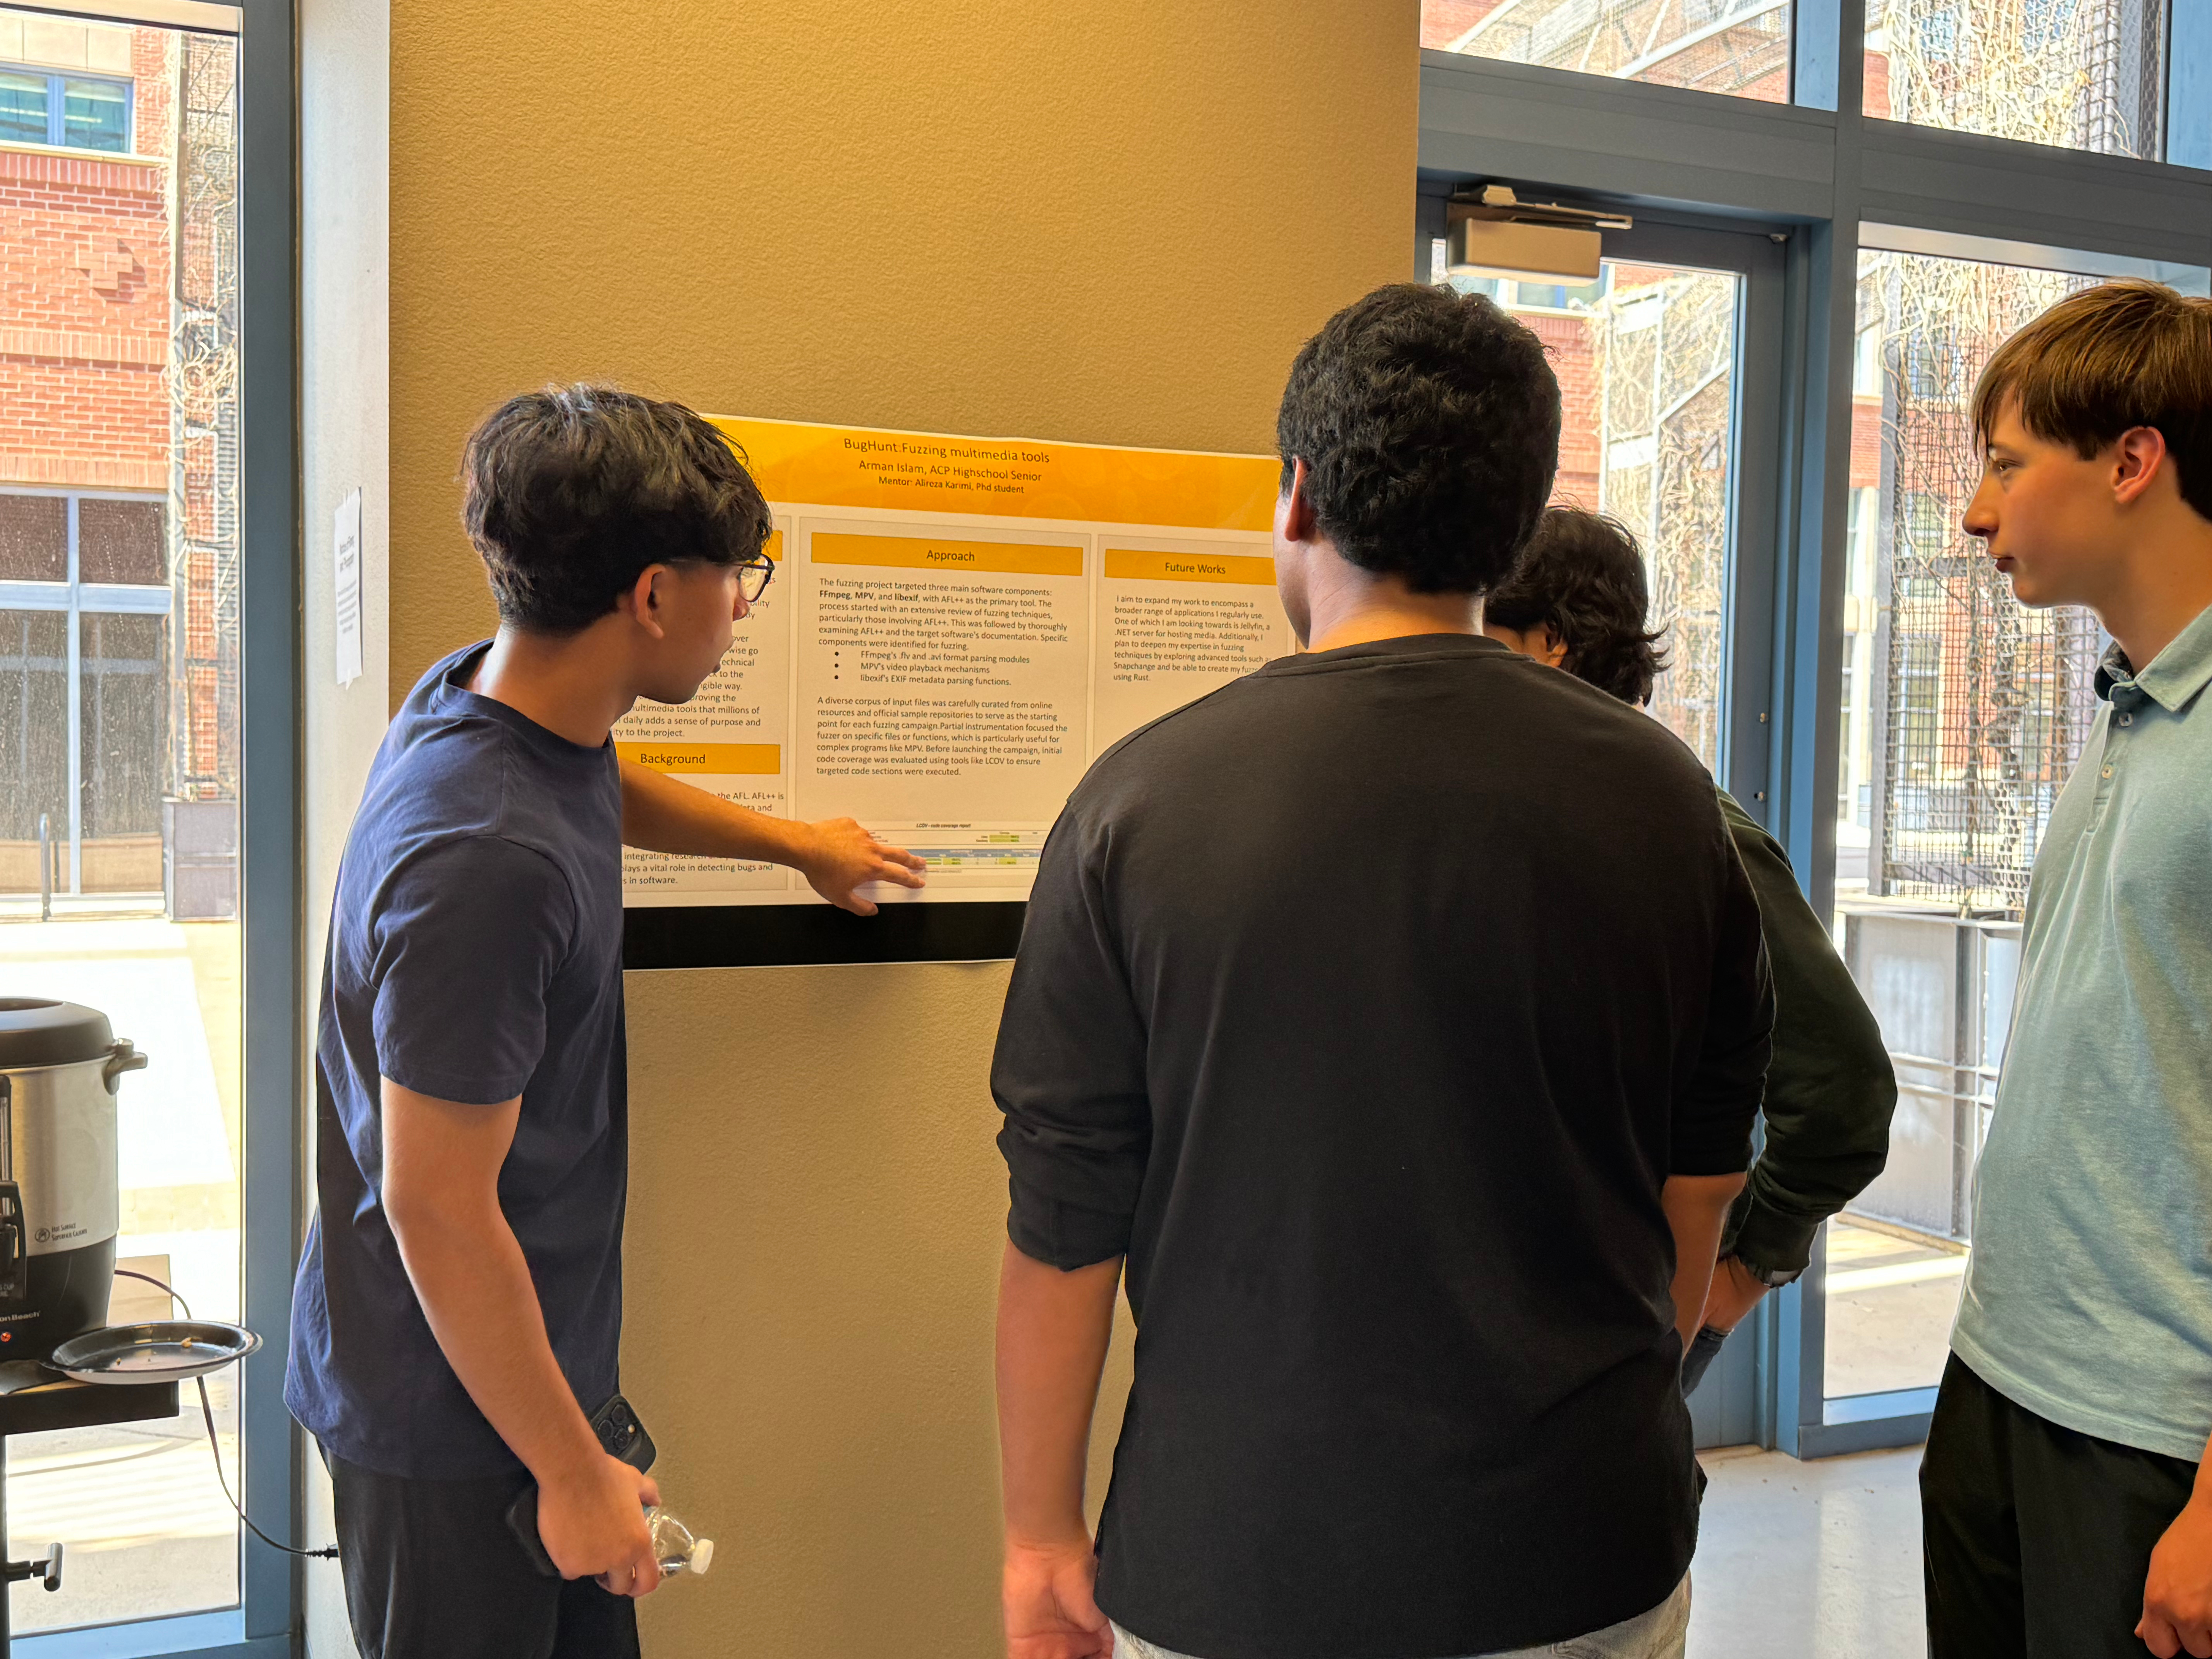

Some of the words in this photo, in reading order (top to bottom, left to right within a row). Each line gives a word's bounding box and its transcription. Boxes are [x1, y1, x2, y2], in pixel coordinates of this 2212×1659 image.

[950, 447, 1018, 460] multimedia
[1022, 452, 1049, 463] tools
[859, 460, 893, 471] Arman
[897, 463, 926, 475] Islam,
[929, 465, 950, 475] ACP
[953, 466, 1008, 479] Highschool
[1011, 470, 1041, 481] Senior
[945, 481, 974, 491] Karimi,
[976, 483, 991, 491] Phd
[994, 484, 1024, 493] student
[926, 550, 974, 562] Approach
[1165, 562, 1195, 573] Future
[1197, 564, 1225, 574] Works
[819, 578, 834, 586] The
[836, 578, 863, 589] fuzzing
[866, 580, 892, 590] project
[895, 582, 926, 591] targeted
[971, 585, 1003, 594] software
[819, 590, 852, 600] FFmpeg,
[855, 592, 876, 601] MPV,
[989, 598, 1018, 607] primary
[880, 604, 896, 612] with
[984, 608, 1009, 618] fuzzing
[1011, 610, 1052, 620] techniques,
[1115, 606, 1142, 614] broader
[1174, 608, 1214, 617] applications
[1220, 611, 1249, 620] regularly
[819, 615, 863, 624] particularly
[865, 615, 886, 623] those
[888, 616, 922, 627] involving
[924, 618, 949, 626] AFL++.
[951, 618, 966, 627] This
[984, 620, 1015, 629] followed
[1017, 621, 1026, 630] by
[1028, 622, 1067, 632] thoroughly
[1178, 620, 1203, 629] looking
[1240, 622, 1264, 631] Jellyfin,
[819, 626, 858, 636] examining
[917, 630, 939, 639] target
[941, 630, 979, 639] software's
[981, 631, 1038, 641] documentation.
[1041, 634, 1067, 642] Specific
[1114, 639, 1129, 648] plan
[1140, 640, 1166, 649] deepen
[1180, 642, 1211, 651] expertise
[1221, 642, 1243, 653] fuzzing
[861, 650, 896, 660] FFmpeg's
[943, 653, 968, 661] format
[970, 655, 997, 664] parsing
[860, 662, 884, 670] MPV's
[886, 663, 907, 671] video
[909, 663, 942, 673] playback
[944, 665, 989, 673] mechanisms
[1113, 673, 1132, 682] using
[699, 705, 715, 713] that
[718, 706, 749, 714] millions
[900, 710, 927, 719] sample
[929, 711, 973, 719] repositories
[1030, 713, 1057, 721] starting
[623, 716, 643, 725] daily
[699, 717, 708, 725] of
[817, 743, 849, 752] complex
[851, 745, 887, 753] programs
[952, 745, 987, 754] launching
[1003, 746, 1040, 755] campaign,
[641, 753, 705, 766] Background
[929, 756, 949, 766] using
[697, 864, 735, 872] detecting
[737, 863, 756, 872] bugs
